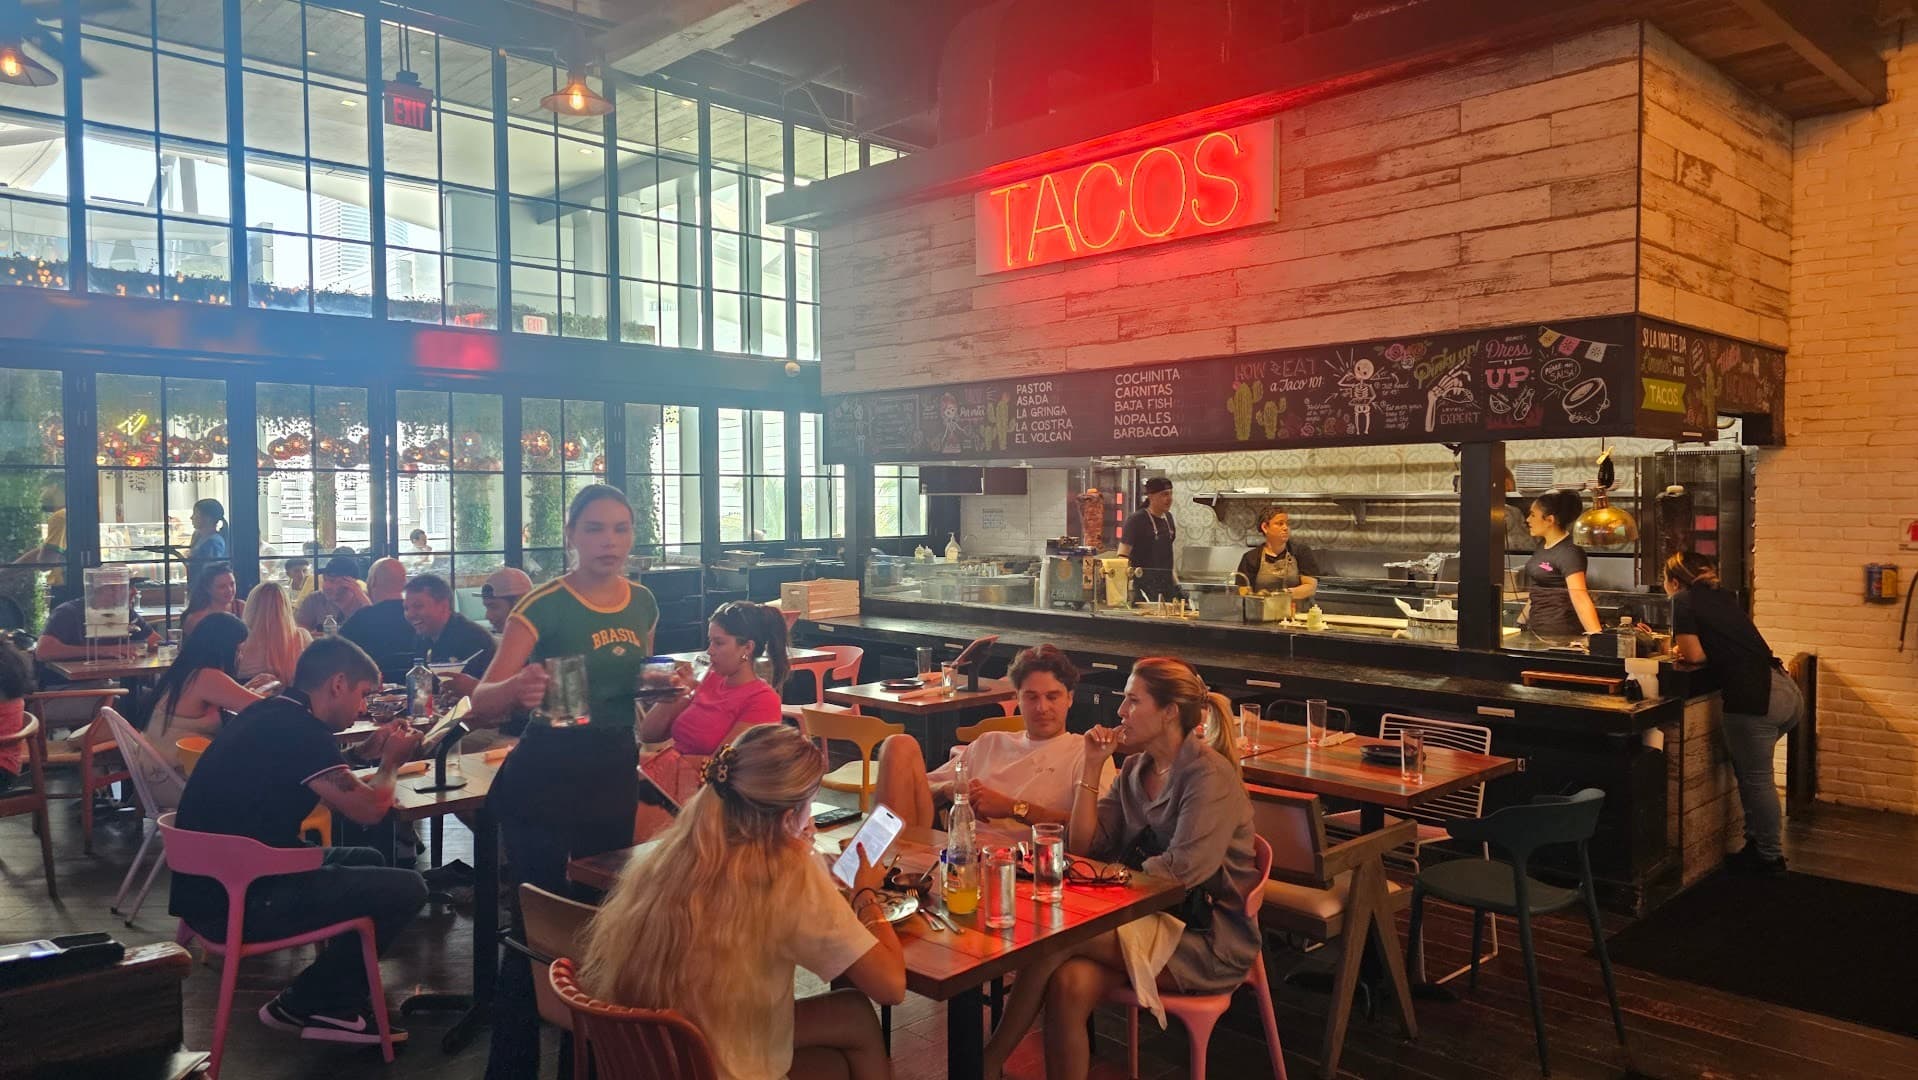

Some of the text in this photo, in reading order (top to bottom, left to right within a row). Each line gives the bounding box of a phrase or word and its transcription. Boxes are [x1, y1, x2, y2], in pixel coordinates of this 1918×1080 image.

[393, 96, 426, 129] EXIT
[990, 131, 1240, 266] TACOS
[1486, 339, 1532, 359] Dress
[1234, 360, 1266, 380] HOW
[1283, 357, 1317, 377] EAT
[1114, 368, 1181, 386] COCHINITA
[1279, 377, 1307, 392] Taco
[1016, 382, 1053, 395] PASTOR
[1114, 384, 1174, 399] CARNITAS
[1649, 385, 1679, 406] TACOS
[1016, 395, 1049, 406] ASADA
[1114, 397, 1173, 412] BAJA FISH
[1016, 405, 1068, 419] LA GRINGA
[1114, 412, 1172, 426] NOPALES
[1440, 411, 1480, 425] EXPERT
[1016, 418, 1074, 432] LA COSTRA
[1113, 425, 1180, 440] BARBACOA
[1015, 430, 1072, 444] EL VOLCAN
[592, 627, 641, 650] BRASIL
